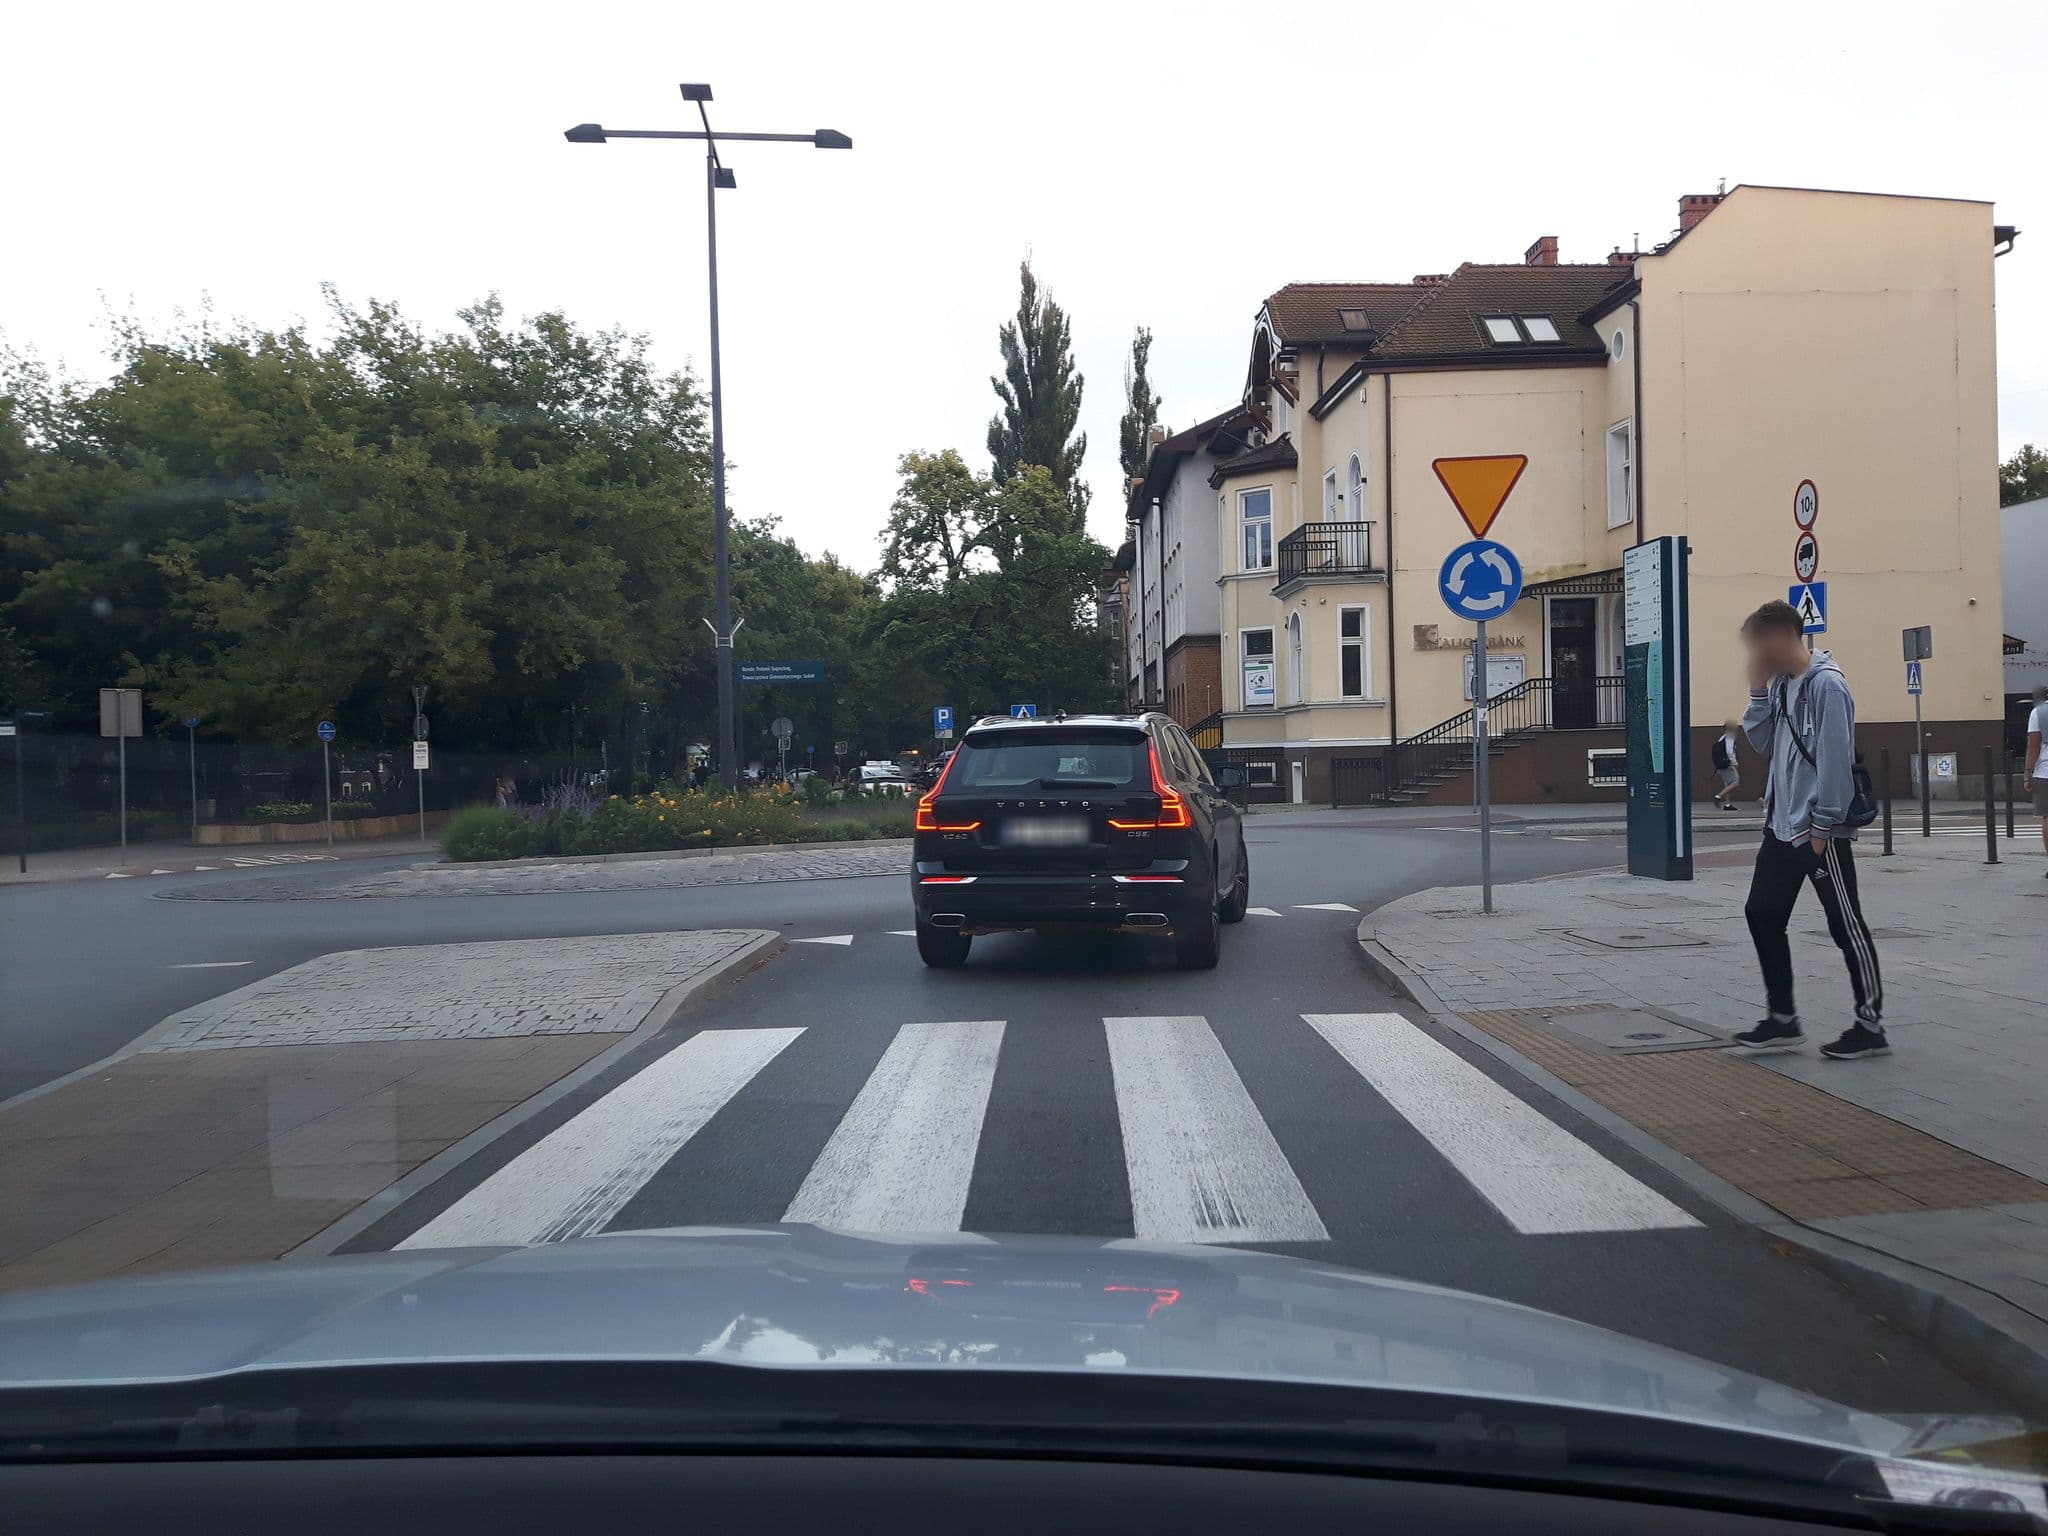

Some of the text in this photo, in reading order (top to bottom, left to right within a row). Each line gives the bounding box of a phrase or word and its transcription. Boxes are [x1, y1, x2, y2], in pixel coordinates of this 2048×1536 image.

[1439, 635, 1525, 650] ALIO BANK
[938, 709, 949, 723] P
